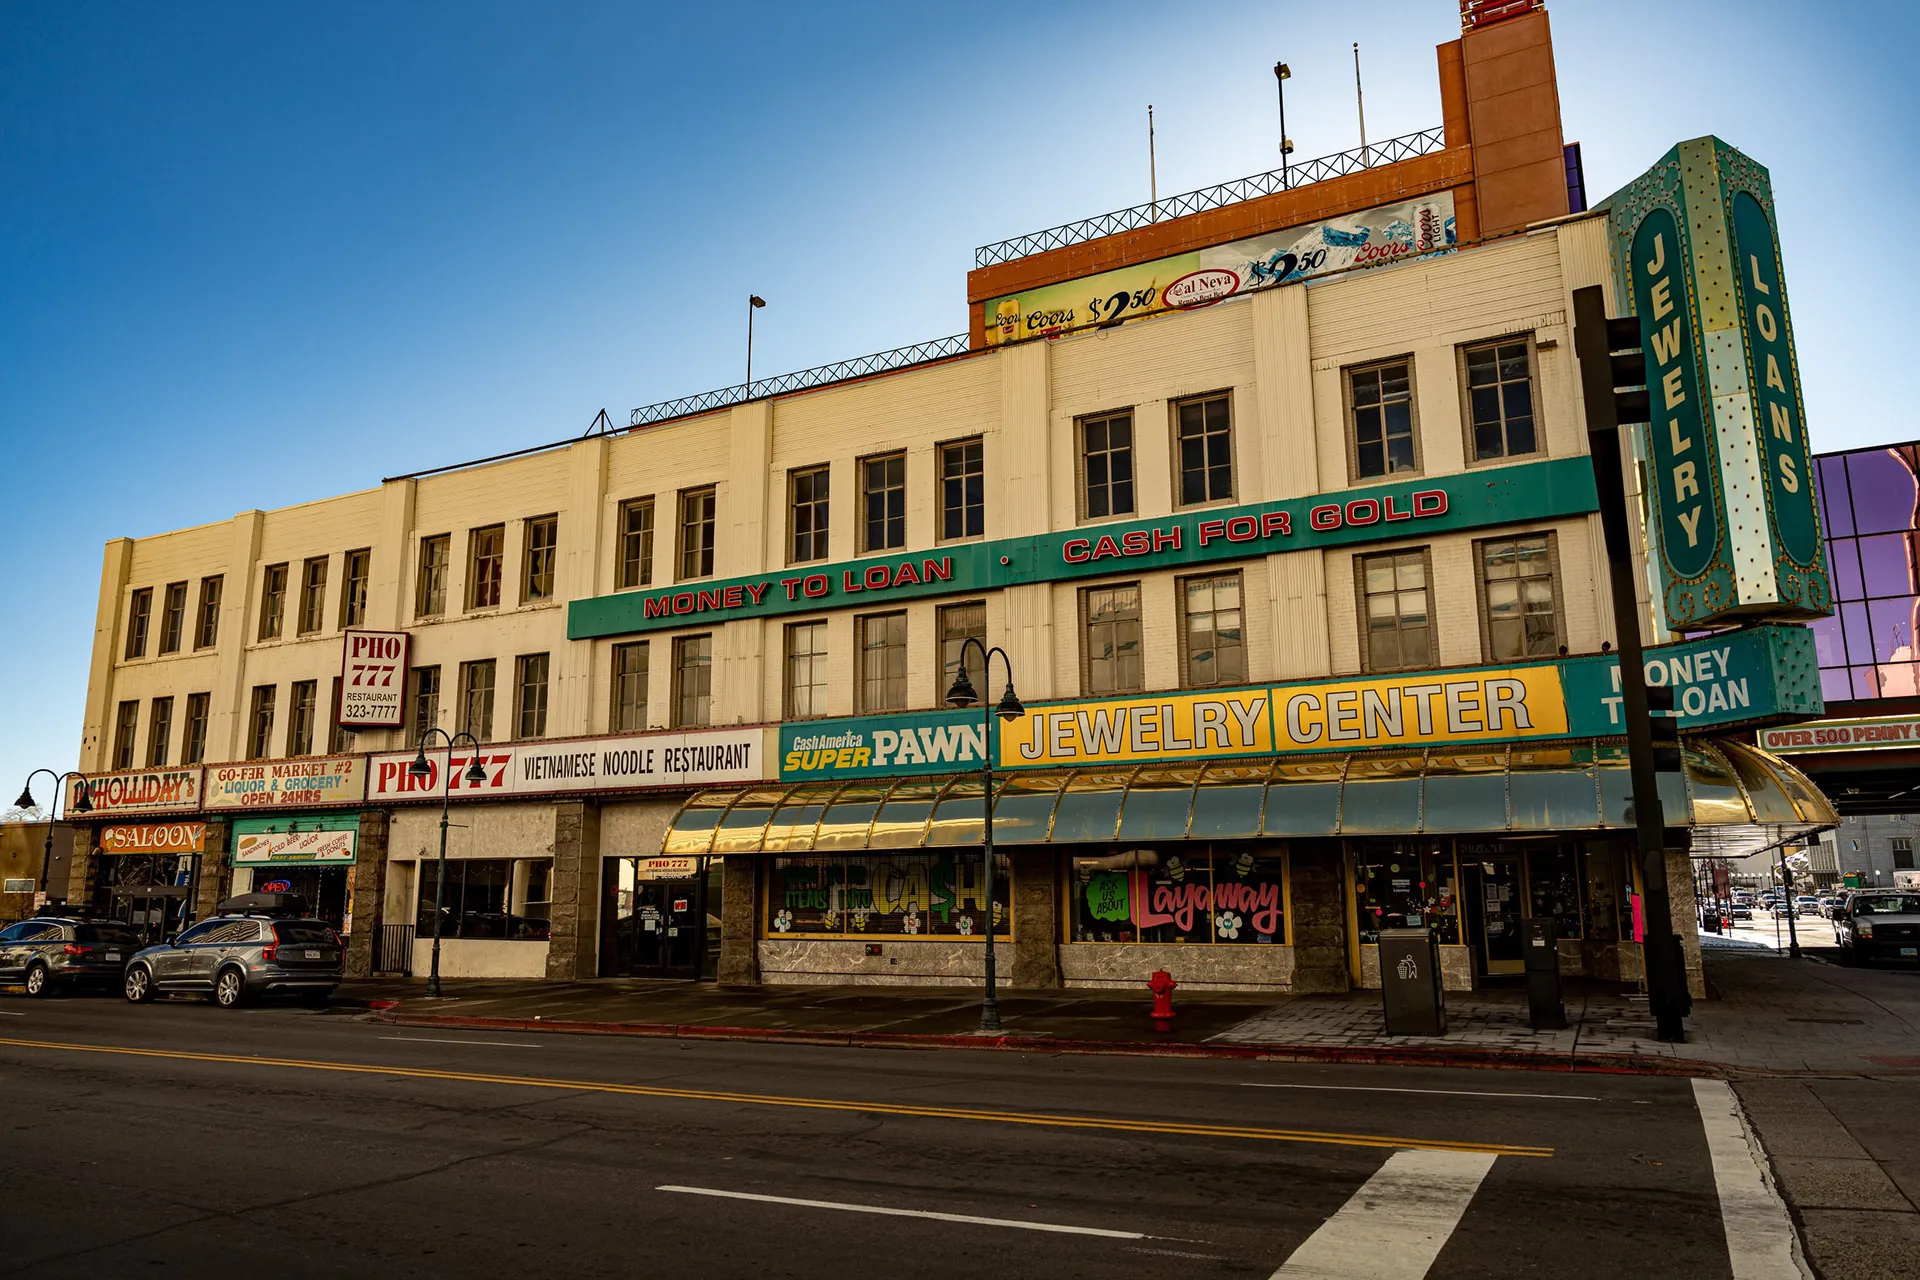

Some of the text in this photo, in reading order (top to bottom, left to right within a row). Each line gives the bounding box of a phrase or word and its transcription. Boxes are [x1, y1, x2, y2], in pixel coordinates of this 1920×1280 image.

[1417, 208, 1434, 251] Coors
[1432, 215, 1441, 243] LIGHT
[1355, 241, 1410, 262] Coors
[1199, 275, 1231, 291] Neva
[1027, 309, 1075, 330] Coors
[1750, 254, 1798, 494] LOANS
[1647, 232, 1701, 548] JEWELRY
[1063, 489, 1449, 564] CASH FOR GOLD
[643, 557, 951, 619] MONEY TO LOAN
[352, 637, 401, 660] PHO
[352, 665, 396, 687] 777
[346, 693, 398, 702] RESTAURANT
[346, 704, 397, 718] 323-7777
[1286, 678, 1534, 743] CENTER
[1020, 698, 1266, 759] JEWELRY
[1767, 730, 1814, 747] OVER
[1815, 728, 1850, 744] 500
[1853, 724, 1912, 743] PENNY
[872, 723, 991, 766] PAWN
[272, 763, 327, 778] MARKET
[334, 761, 352, 774] #2
[524, 743, 751, 780] VIETNAMESE NOODLE RESTAURANT
[783, 747, 872, 771] SUPER
[377, 754, 512, 793] PHO 777
[225, 776, 342, 794] LIQUOR & GROCERY
[241, 790, 321, 806] OPEN 24HRS
[114, 826, 198, 849] SALOON
[271, 834, 300, 854] COLD BEER
[299, 834, 319, 849] LIQUOR
[317, 833, 348, 854] FRESH COFFEE
[242, 839, 270, 858] SANDWICHES
[648, 860, 689, 868] PHO 777
[261, 882, 288, 893] OPEN
[1099, 879, 1119, 893] ASK
[1102, 890, 1115, 901] US
[1097, 899, 1126, 915] ABOUT
[1129, 871, 1284, 934] Layaway
